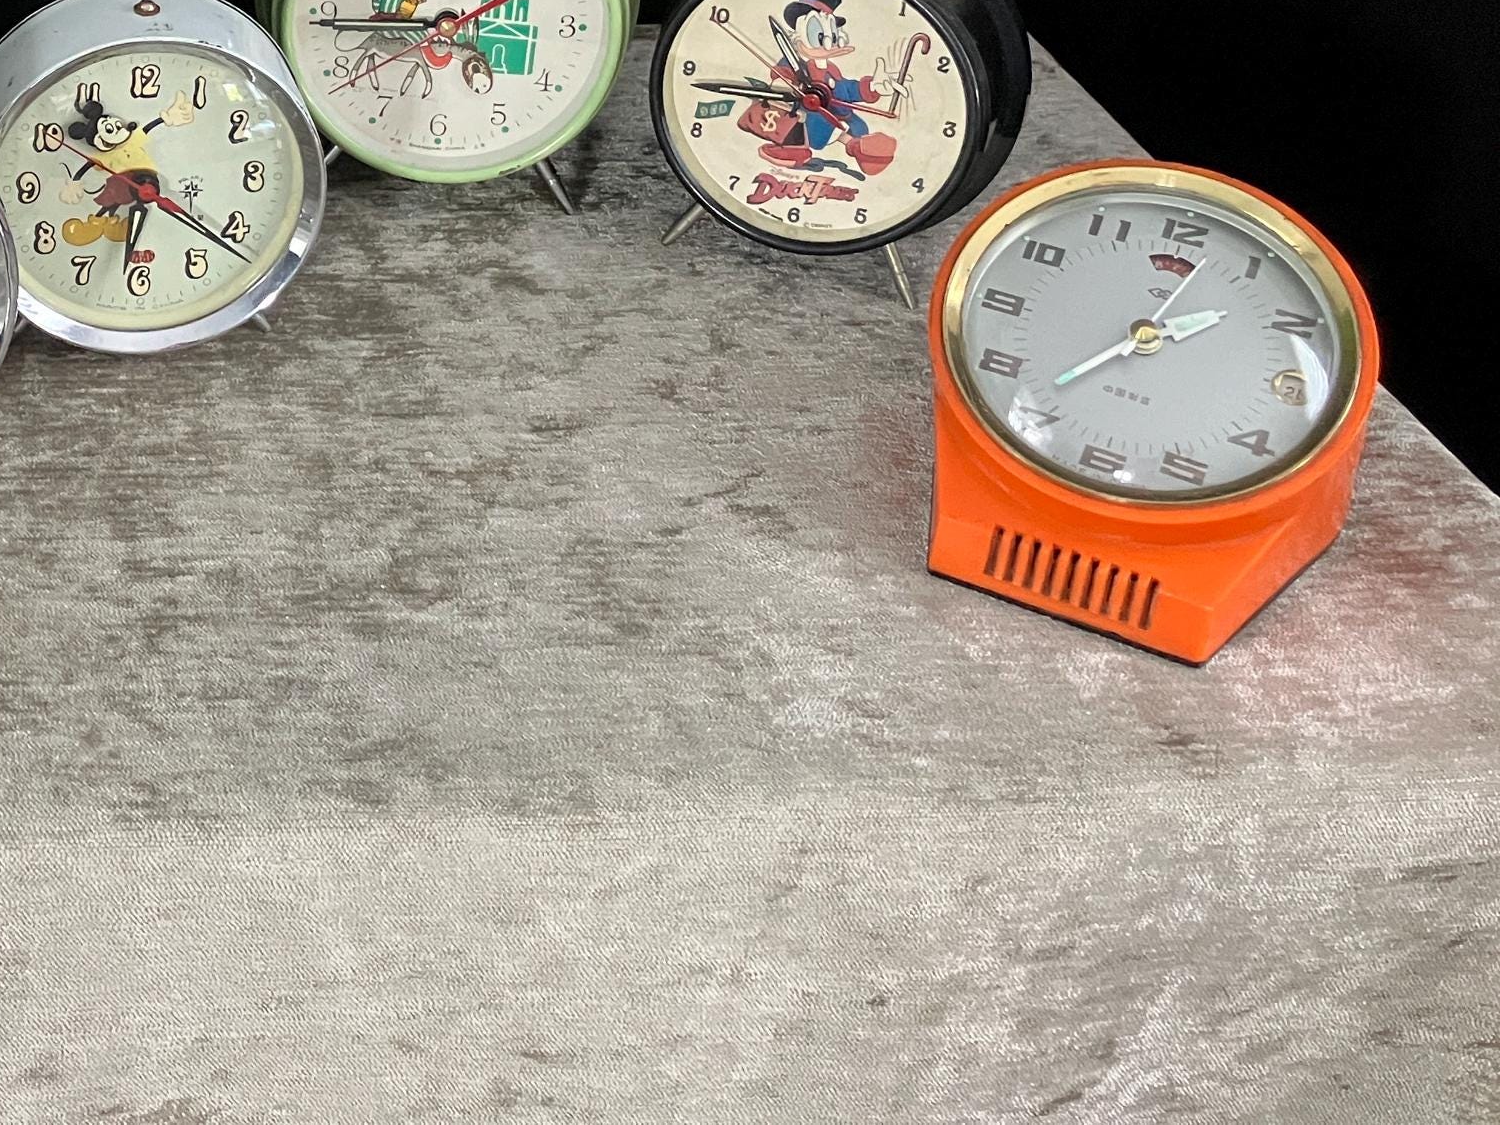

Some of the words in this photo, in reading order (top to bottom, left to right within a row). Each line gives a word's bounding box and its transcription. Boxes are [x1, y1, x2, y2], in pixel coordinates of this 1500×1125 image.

[710, 6, 729, 23] 10
[899, 2, 906, 17] 1
[559, 16, 576, 38] 3
[333, 55, 350, 78] 8
[533, 67, 554, 91] 4
[682, 61, 696, 76] 9
[938, 57, 950, 73] 2
[131, 64, 160, 98] 12
[193, 76, 206, 109] 1
[75, 83, 100, 113] 11
[376, 96, 394, 118] 7
[228, 110, 249, 144] 2
[429, 114, 447, 137] 6
[491, 104, 506, 125] 5
[33, 123, 64, 152] 10
[691, 122, 702, 137] 8
[944, 122, 956, 137] 3
[16, 172, 41, 203] 9
[243, 161, 264, 192] 3
[729, 175, 740, 190] 7
[912, 178, 925, 193] 4
[221, 211, 250, 243] 4
[788, 208, 799, 222] 6
[854, 209, 867, 224] 5
[1088, 214, 1131, 242] 11
[34, 221, 56, 253] 8
[1162, 218, 1209, 246] 12
[185, 248, 208, 279] 5
[1023, 239, 1066, 267] 10
[71, 256, 96, 285] 7
[127, 267, 151, 296] 6
[1245, 256, 1261, 279] 1
[981, 288, 1025, 316] 9
[1274, 309, 1318, 339] 2
[979, 348, 1023, 378] 8
[1019, 406, 1060, 428] 7
[1228, 429, 1274, 458] 4
[1079, 445, 1127, 473] 6
[1160, 452, 1209, 484] 5
